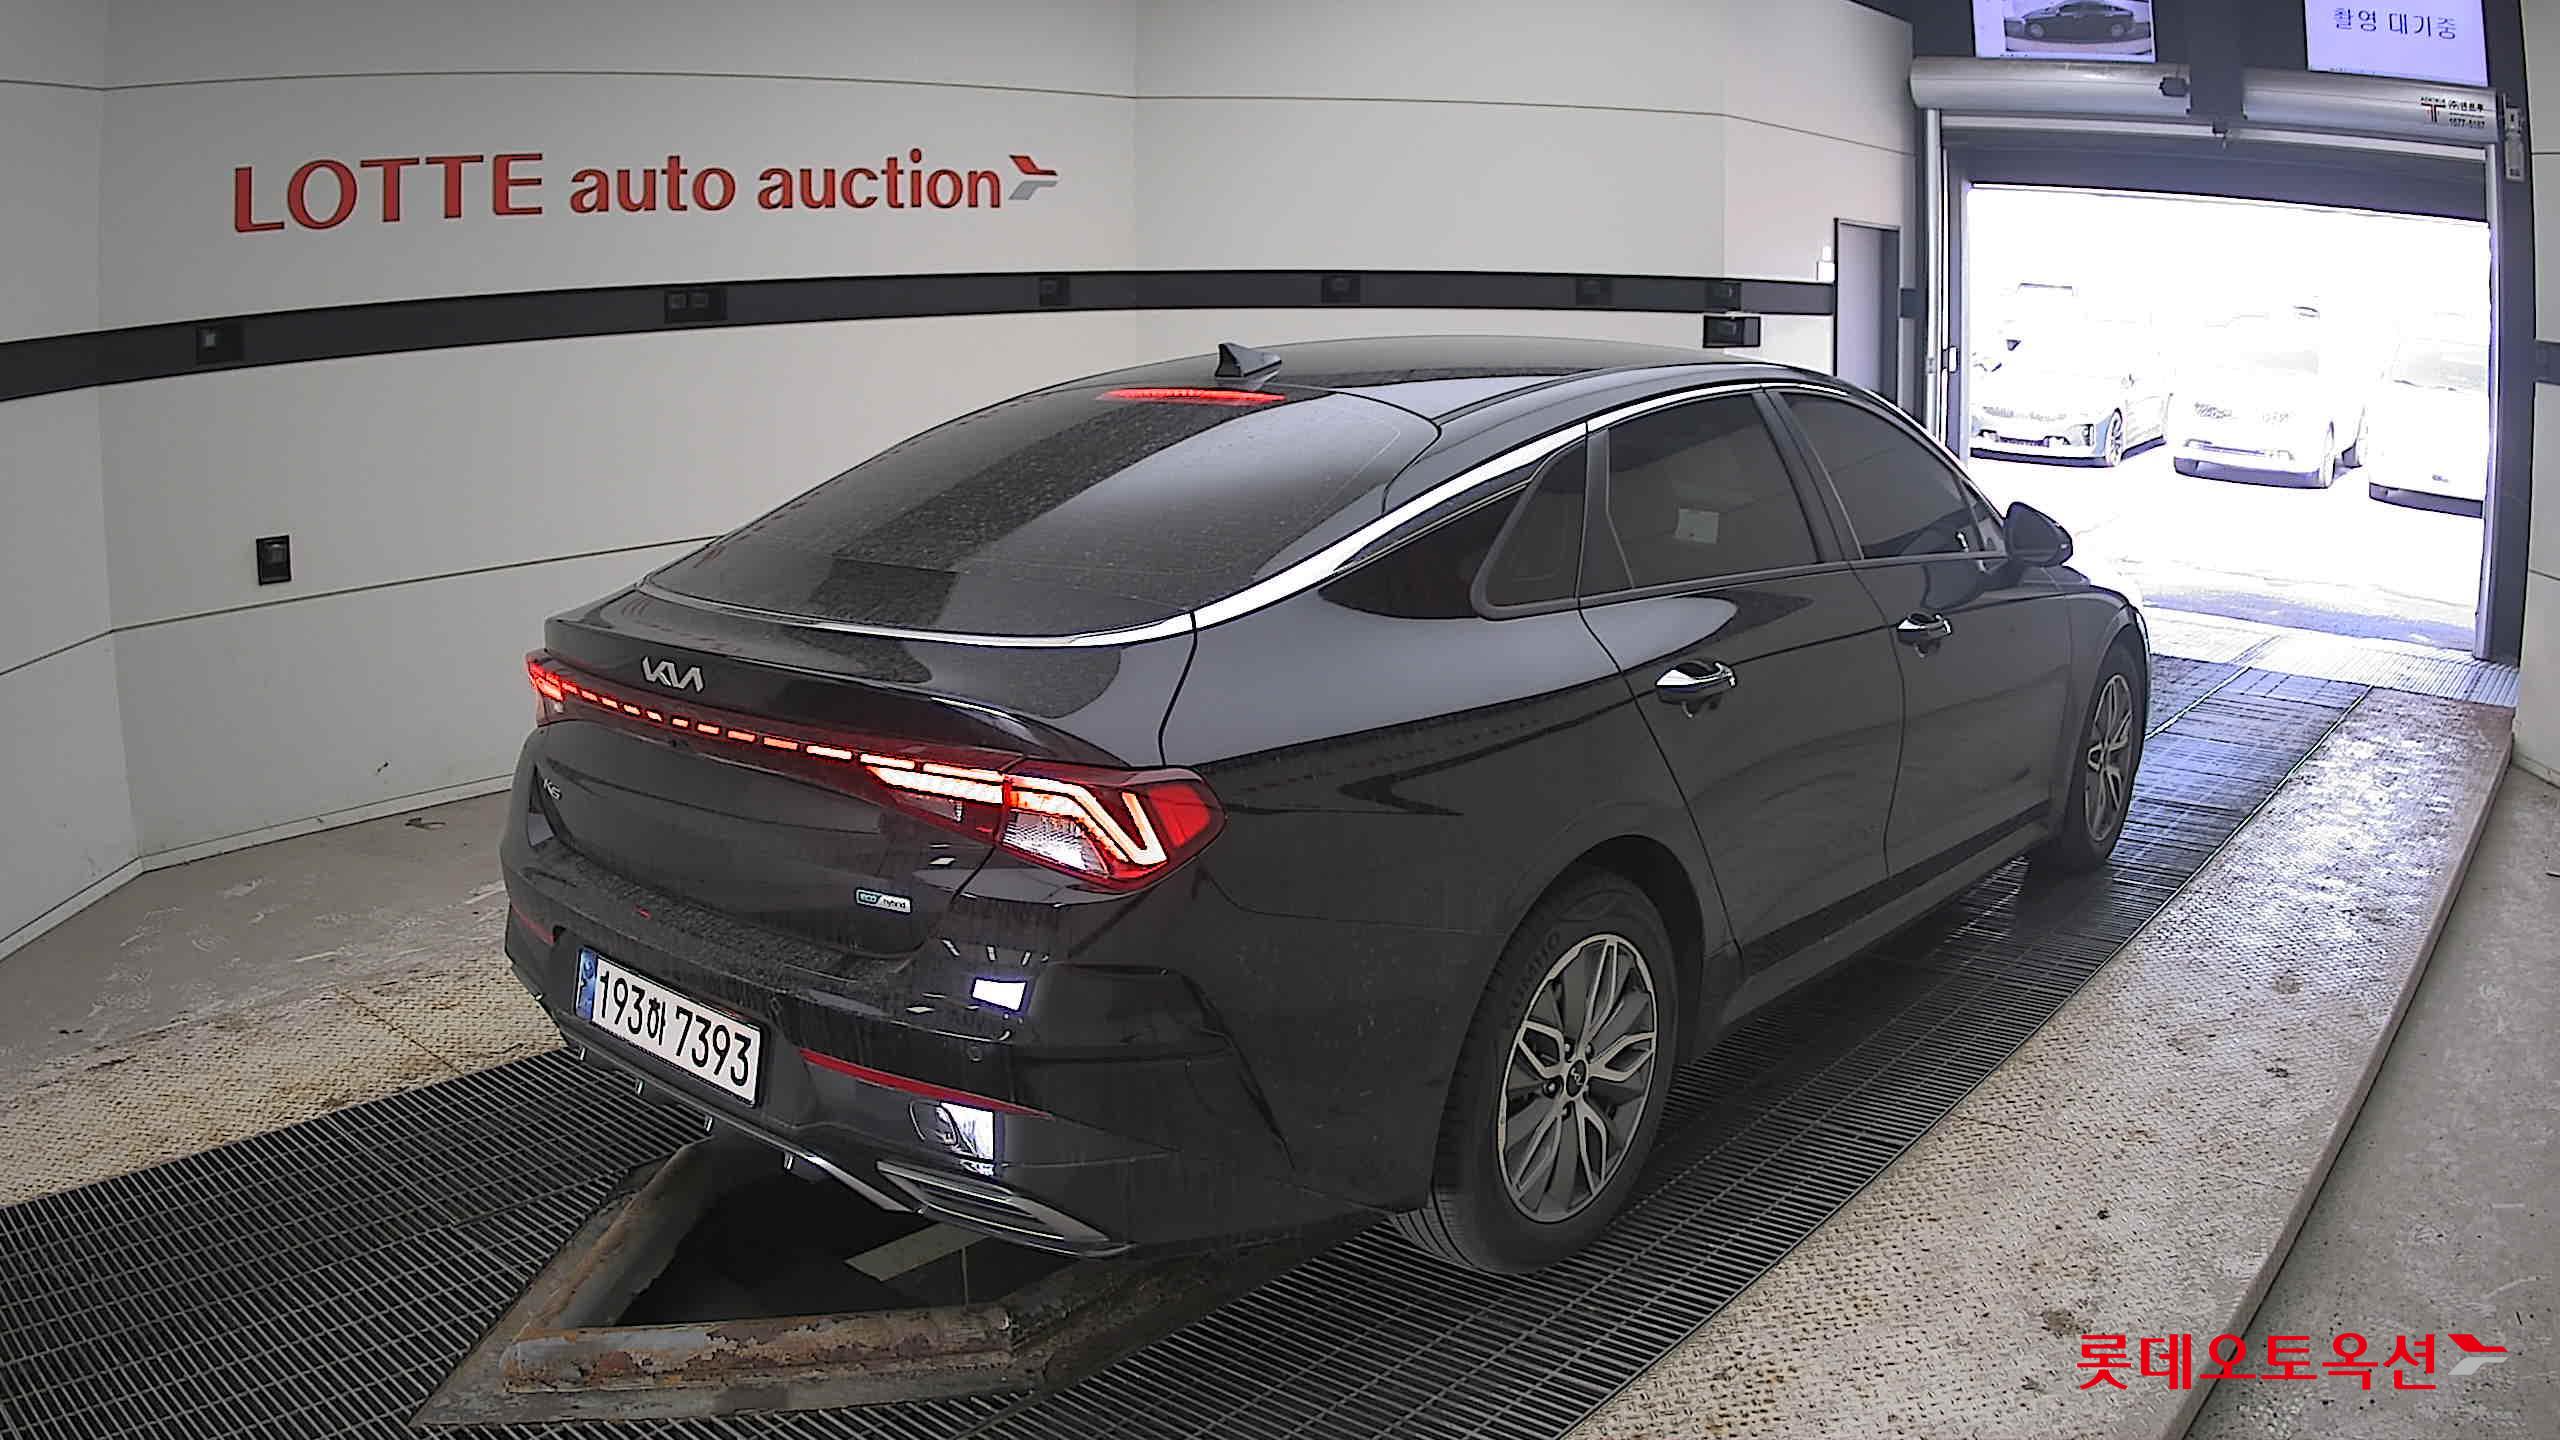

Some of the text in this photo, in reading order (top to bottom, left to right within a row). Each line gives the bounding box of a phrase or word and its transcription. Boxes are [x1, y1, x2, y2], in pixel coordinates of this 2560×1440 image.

[2389, 12, 2457, 40] 대기중
[235, 147, 1001, 233] LOTTE auto auction
[641, 656, 704, 692] KIA
[599, 970, 752, 1087] 193하 7393
